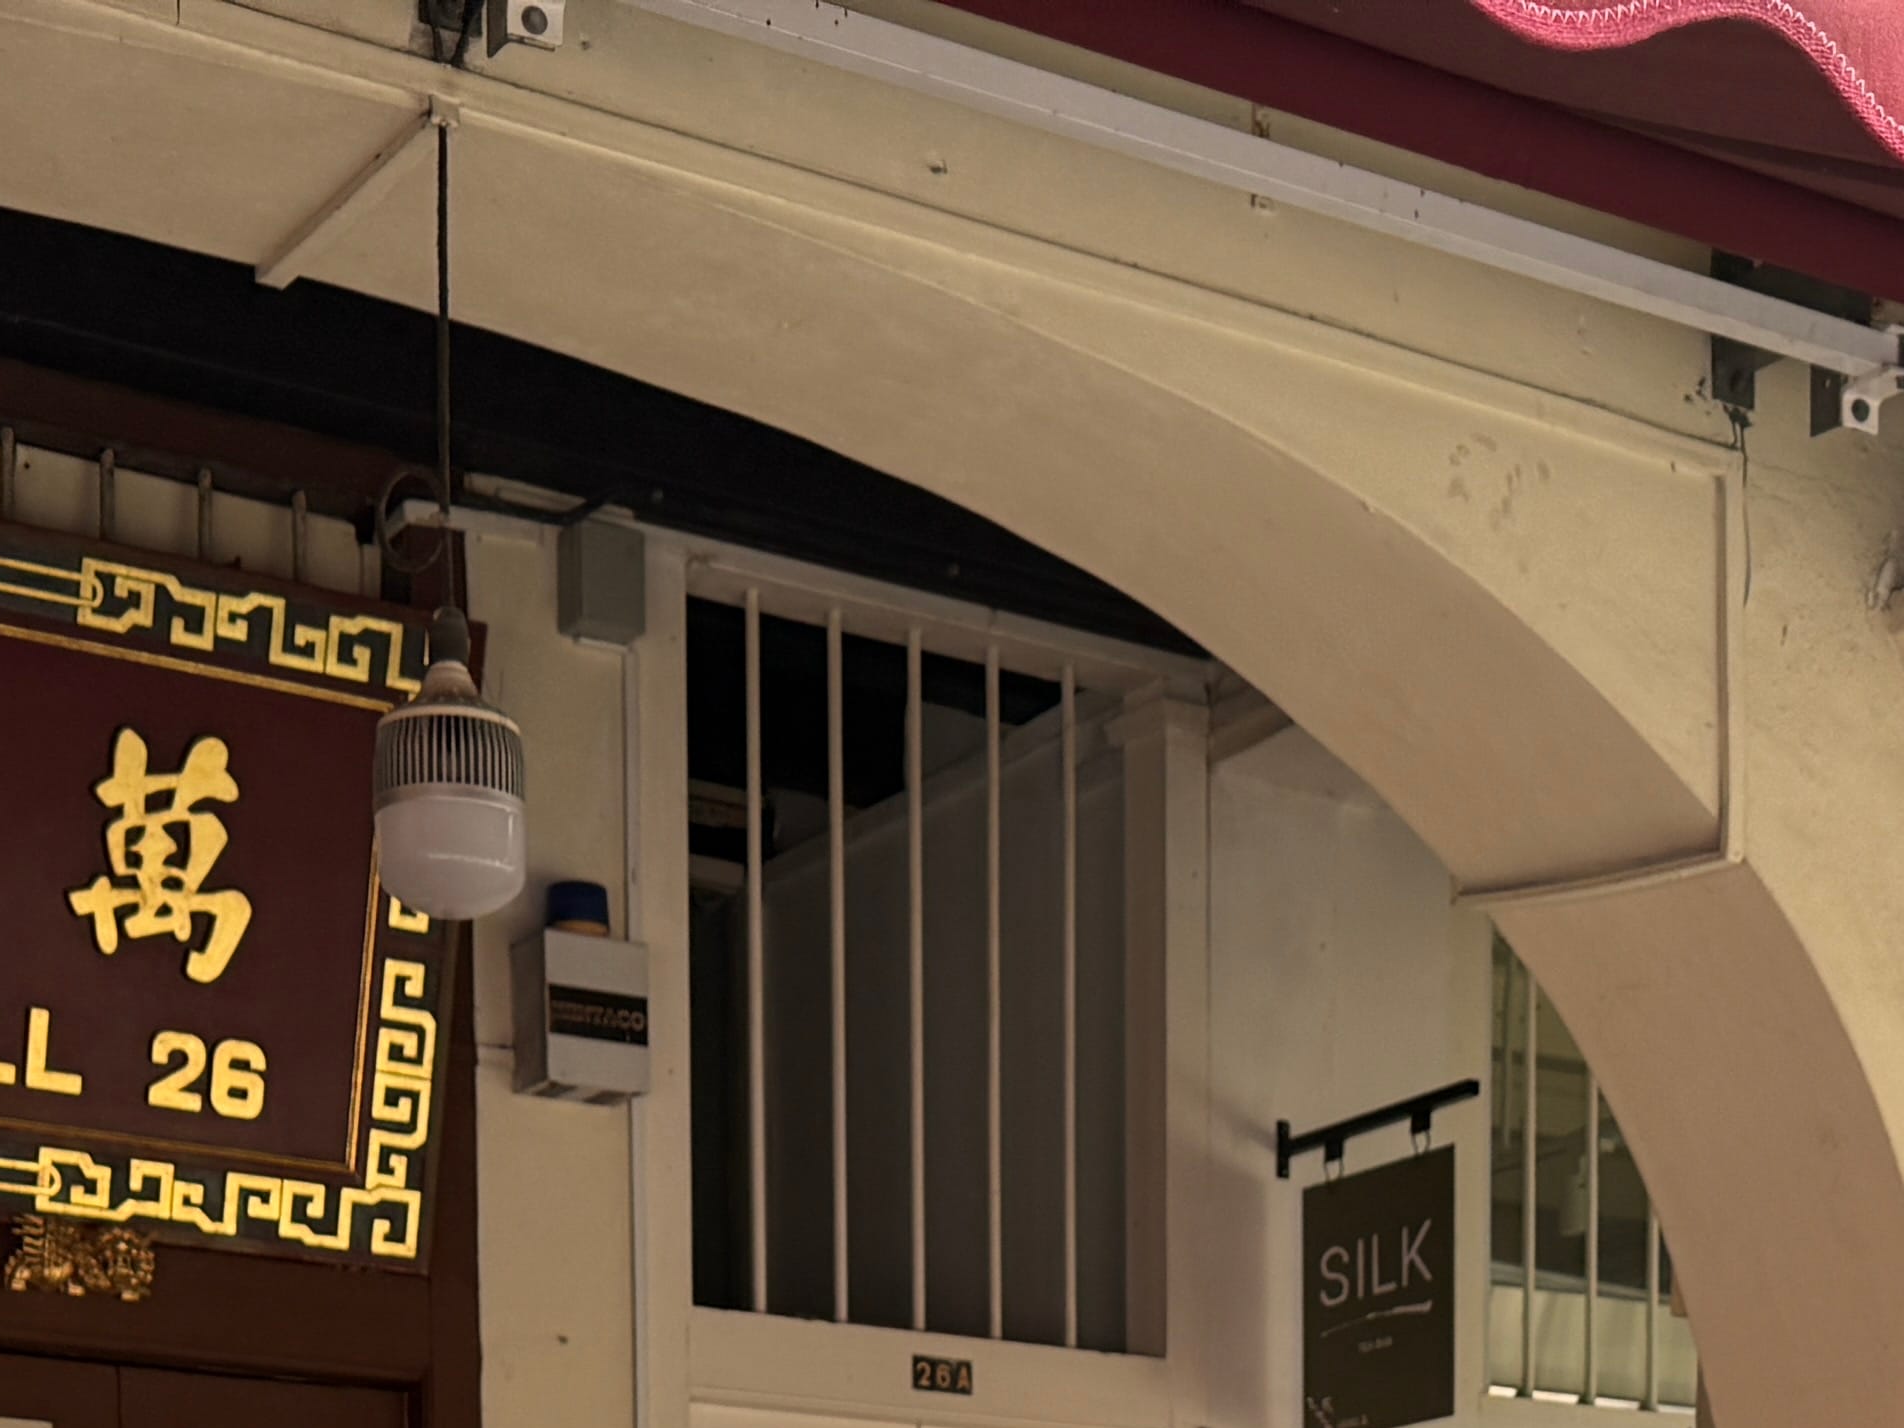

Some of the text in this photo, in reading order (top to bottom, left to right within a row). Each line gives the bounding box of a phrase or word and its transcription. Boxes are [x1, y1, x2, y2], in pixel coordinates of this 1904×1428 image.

[146, 1030, 269, 1122] 26
[1319, 1219, 1433, 1309] SILK
[916, 1361, 971, 1389] 26A
